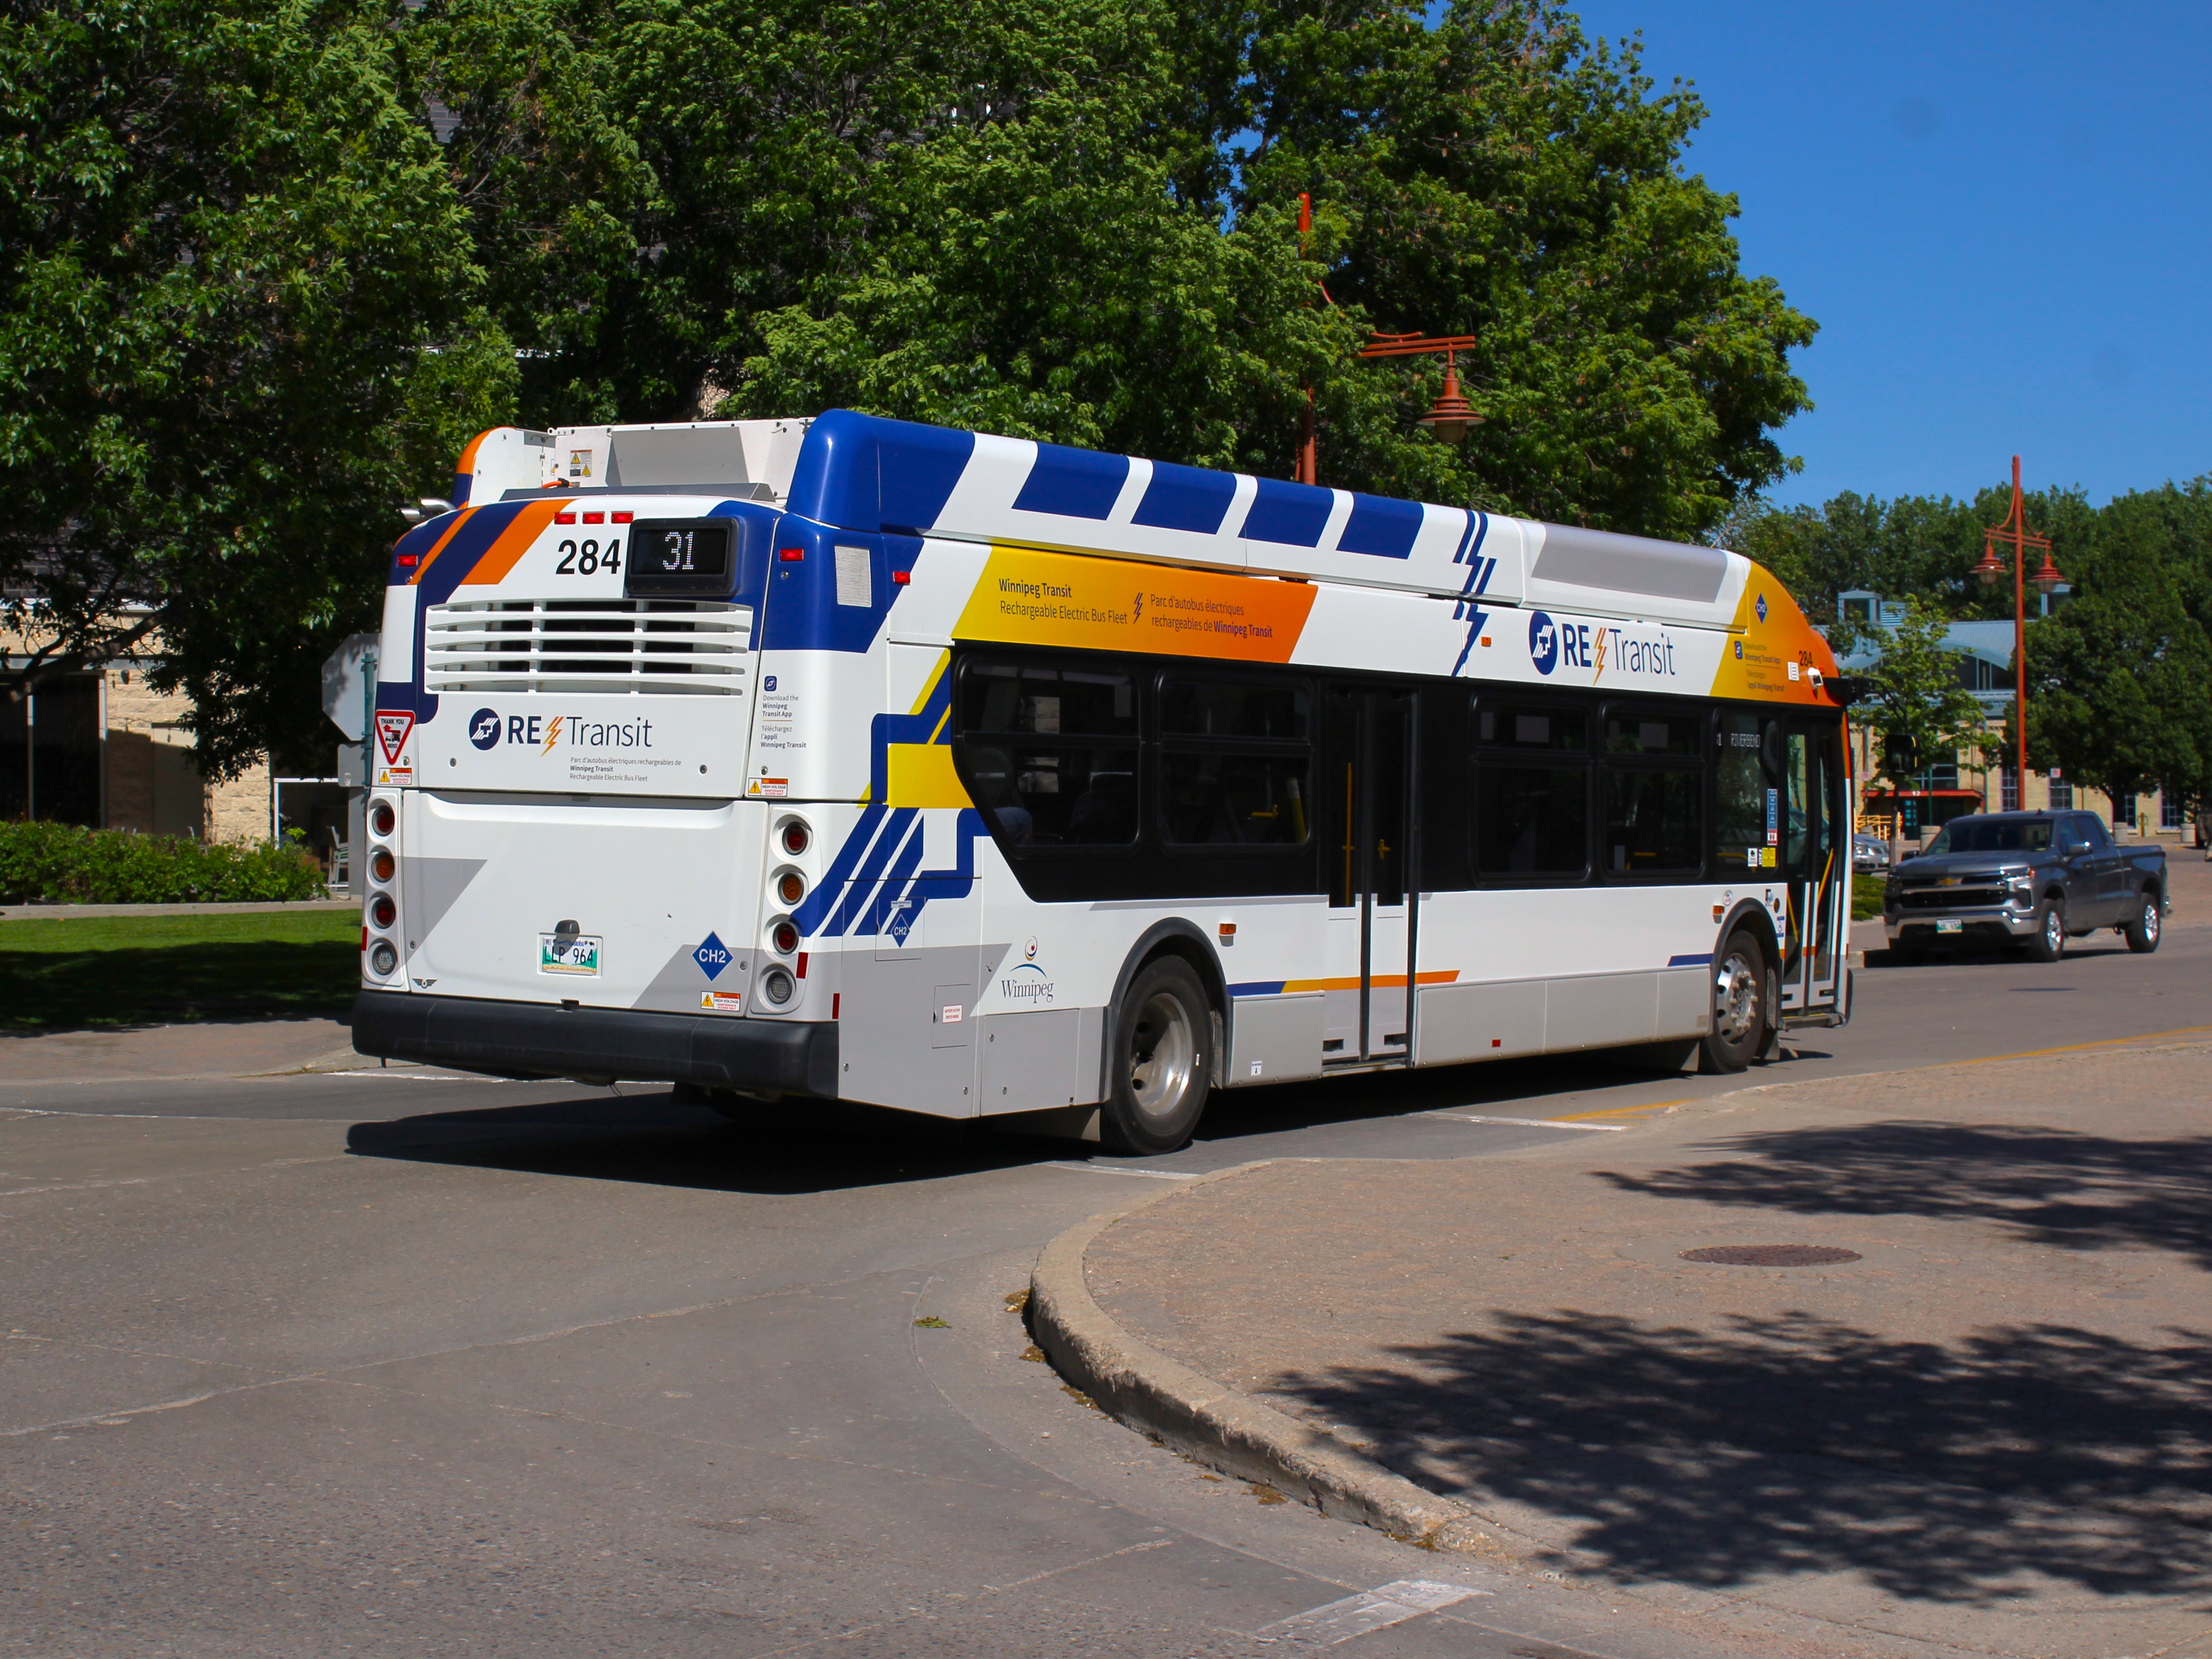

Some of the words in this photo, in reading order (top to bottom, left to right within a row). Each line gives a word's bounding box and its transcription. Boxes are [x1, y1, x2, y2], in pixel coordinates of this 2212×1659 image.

[556, 539, 621, 575] 284
[662, 531, 695, 570] 31
[999, 578, 1040, 599] Winnipeg
[1041, 582, 1072, 598] Transit
[1000, 600, 1057, 620] Rechargeable
[1059, 605, 1089, 621] Electric
[1092, 608, 1106, 622] Bus
[1108, 610, 1127, 624] Fleet
[1151, 594, 1166, 607] Parc
[1169, 595, 1204, 611] d'autobus
[1206, 599, 1244, 618] électriques
[1757, 603, 1766, 612] CH2
[1152, 614, 1202, 632] rechargeables
[1204, 619, 1212, 632] de
[1214, 620, 1247, 638] Winnipeg
[1248, 624, 1273, 638] Transit
[1561, 623, 1592, 667] RE
[1608, 628, 1675, 675] Transit
[1745, 653, 1761, 663] Winnipeg
[1799, 650, 1813, 667] 284
[1758, 682, 1772, 692] Winnipeg
[508, 716, 542, 745] RE
[566, 716, 653, 748] Transit
[1731, 733, 1760, 747] RIVERBEND
[637, 758, 674, 766] rechargeables
[894, 927, 907, 936] CH2
[544, 946, 565, 963] LLP
[573, 948, 593, 965] 964
[698, 948, 726, 963] CH2
[1001, 979, 1054, 1003] Winnipeg
